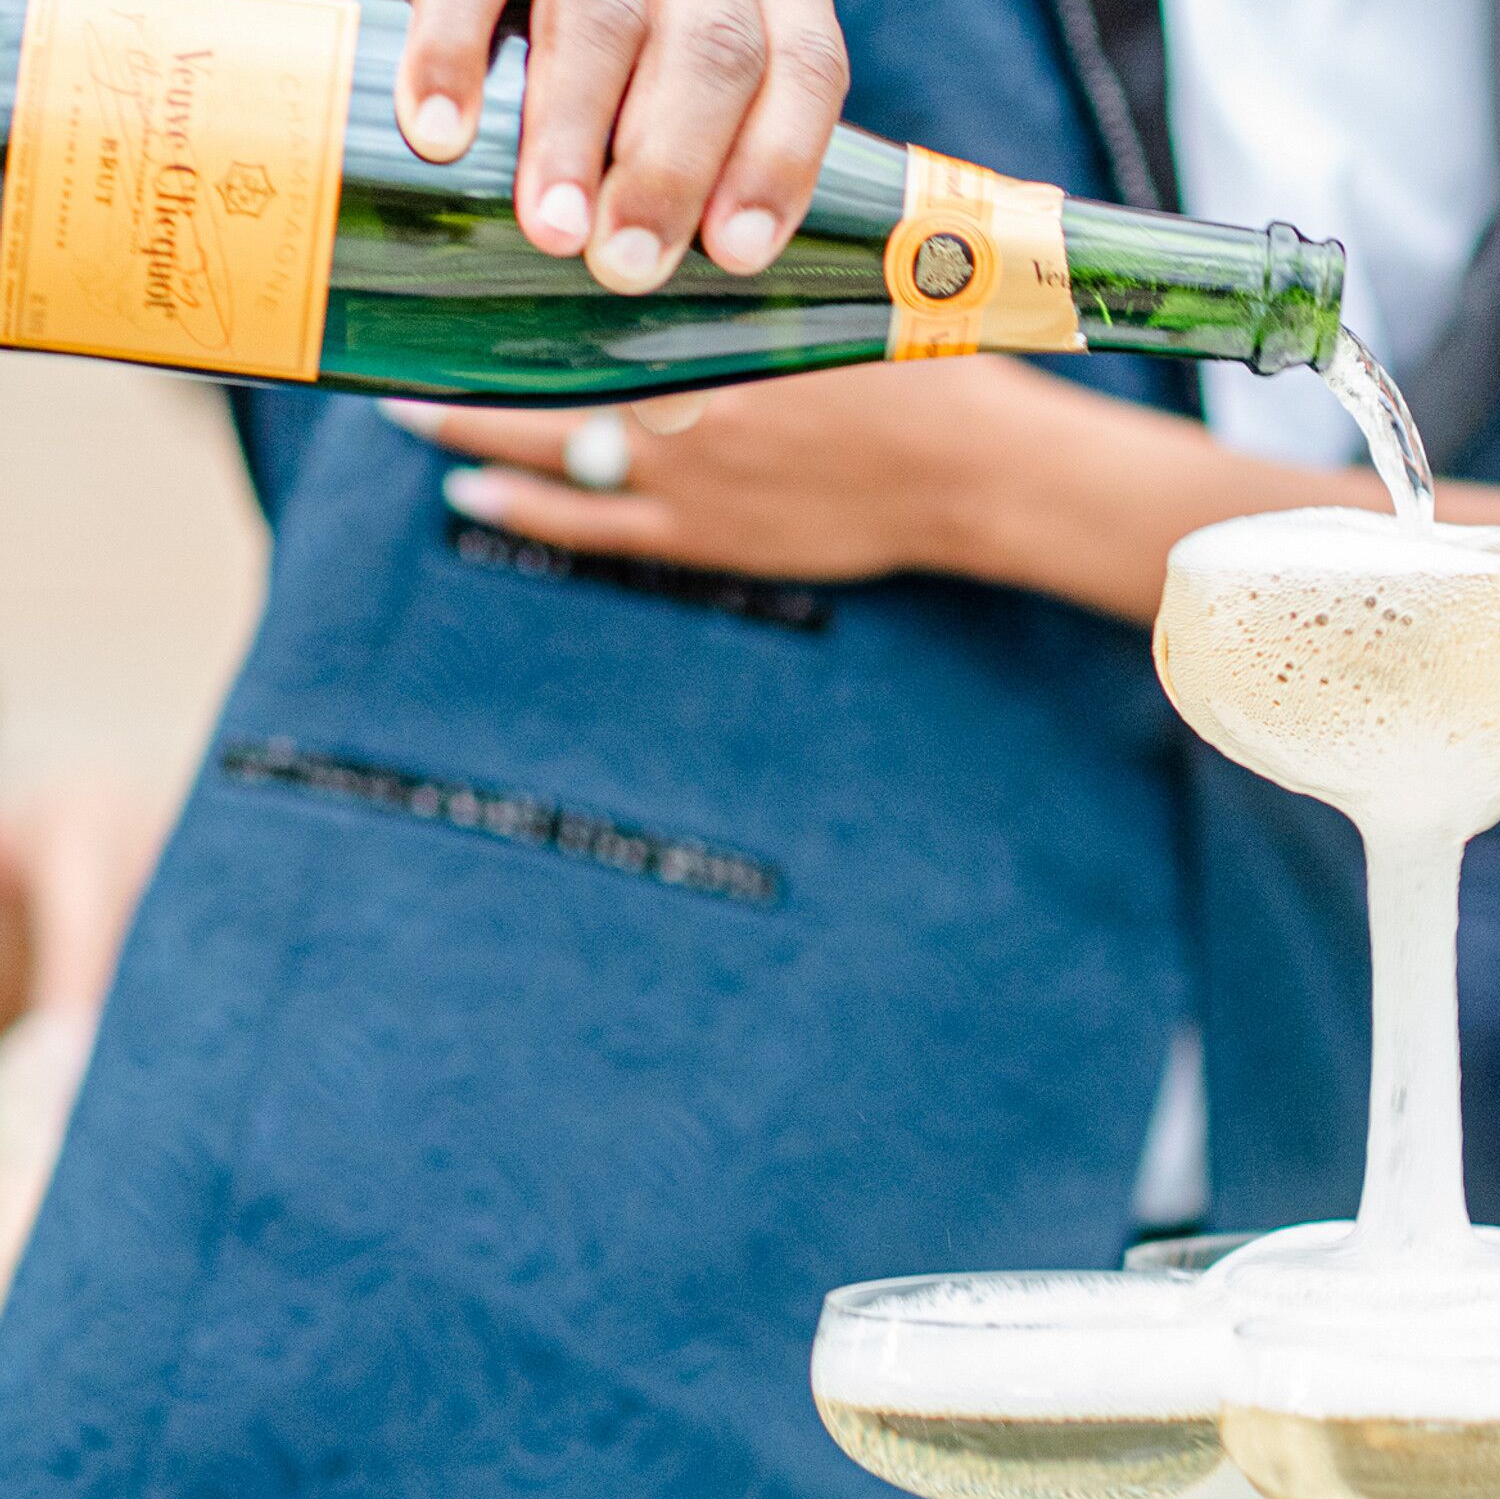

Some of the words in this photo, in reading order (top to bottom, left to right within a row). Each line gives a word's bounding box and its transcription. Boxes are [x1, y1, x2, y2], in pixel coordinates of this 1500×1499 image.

[166, 49, 214, 151] Veuve
[95, 137, 119, 209] BRUT
[256, 71, 312, 313] CHAMPAGNE
[139, 162, 198, 321] Clicquot
